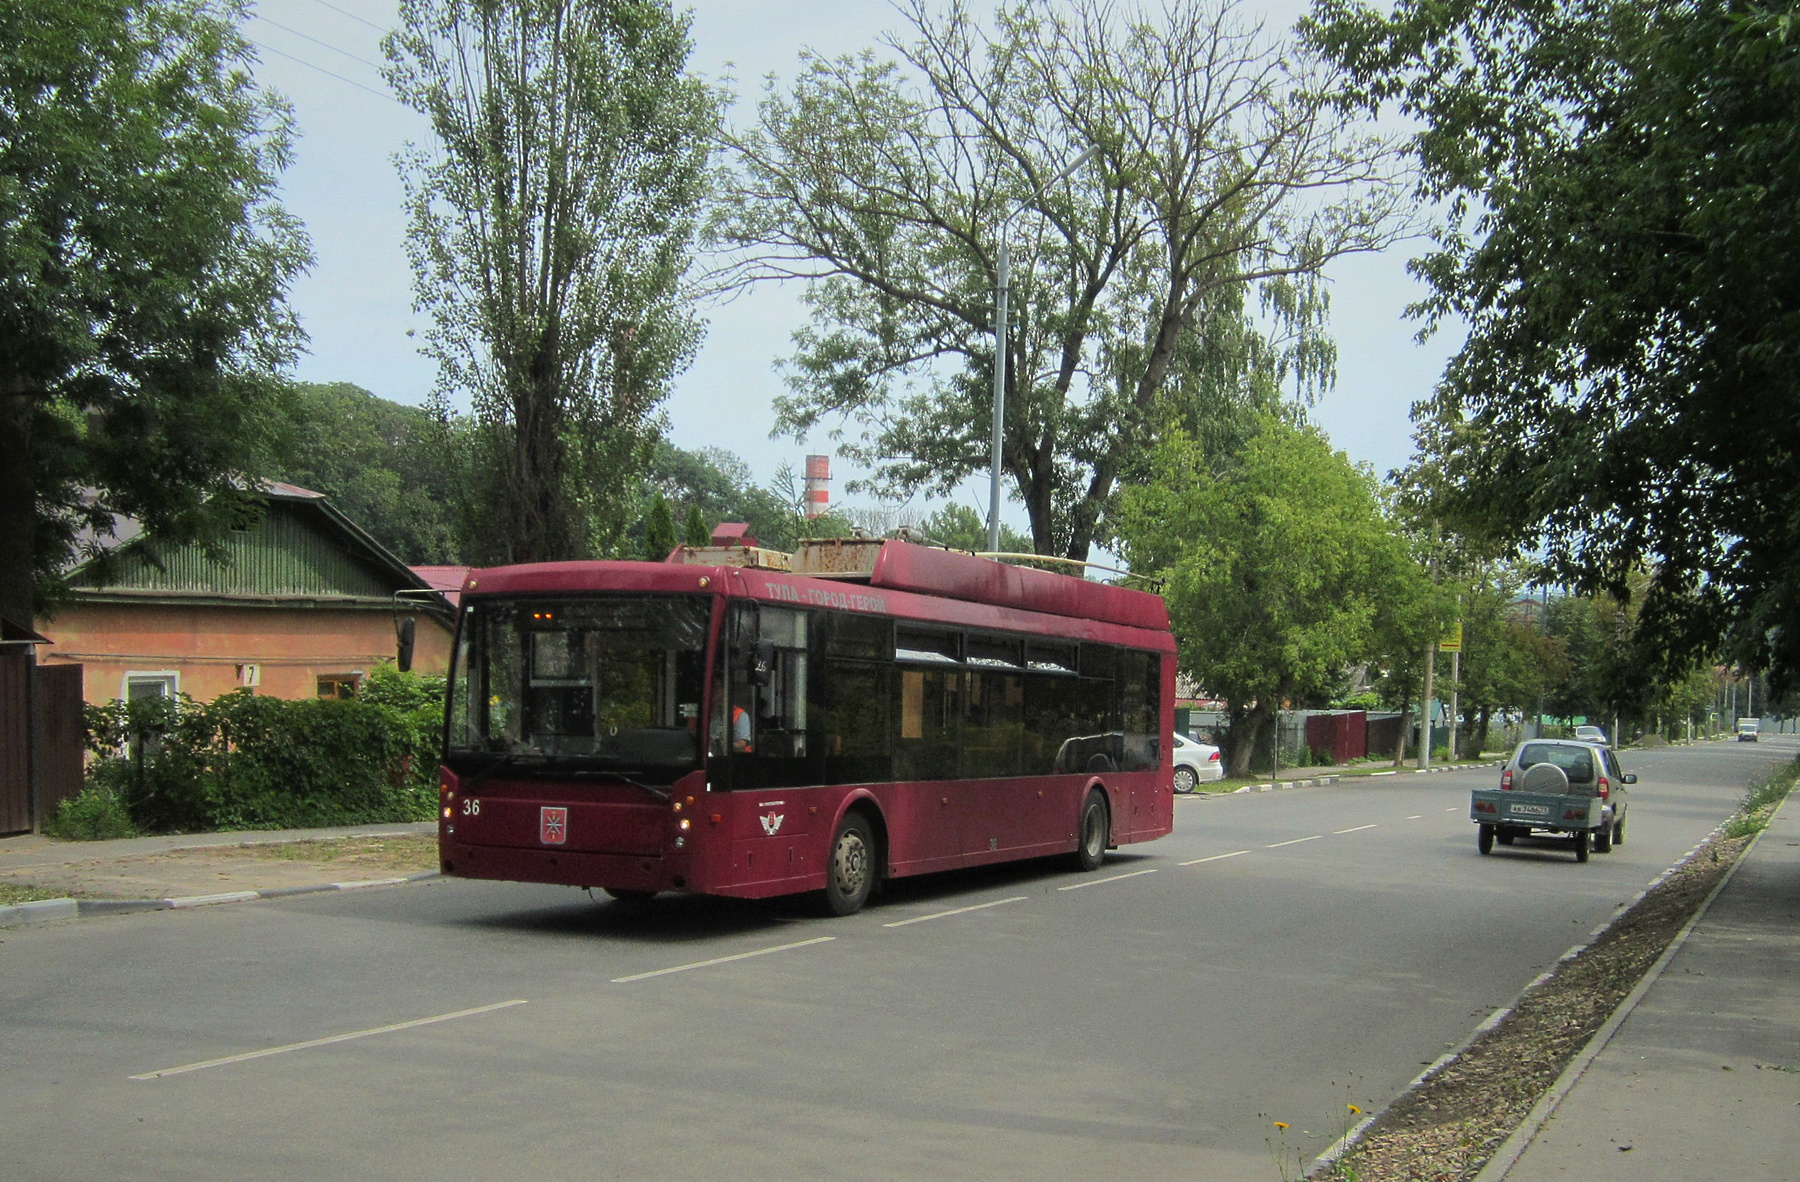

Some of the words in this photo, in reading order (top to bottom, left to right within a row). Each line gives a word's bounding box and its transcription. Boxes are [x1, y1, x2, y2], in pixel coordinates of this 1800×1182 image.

[765, 582, 800, 603] ТУЛА
[249, 666, 254, 684] 7
[463, 799, 480, 815] 36
